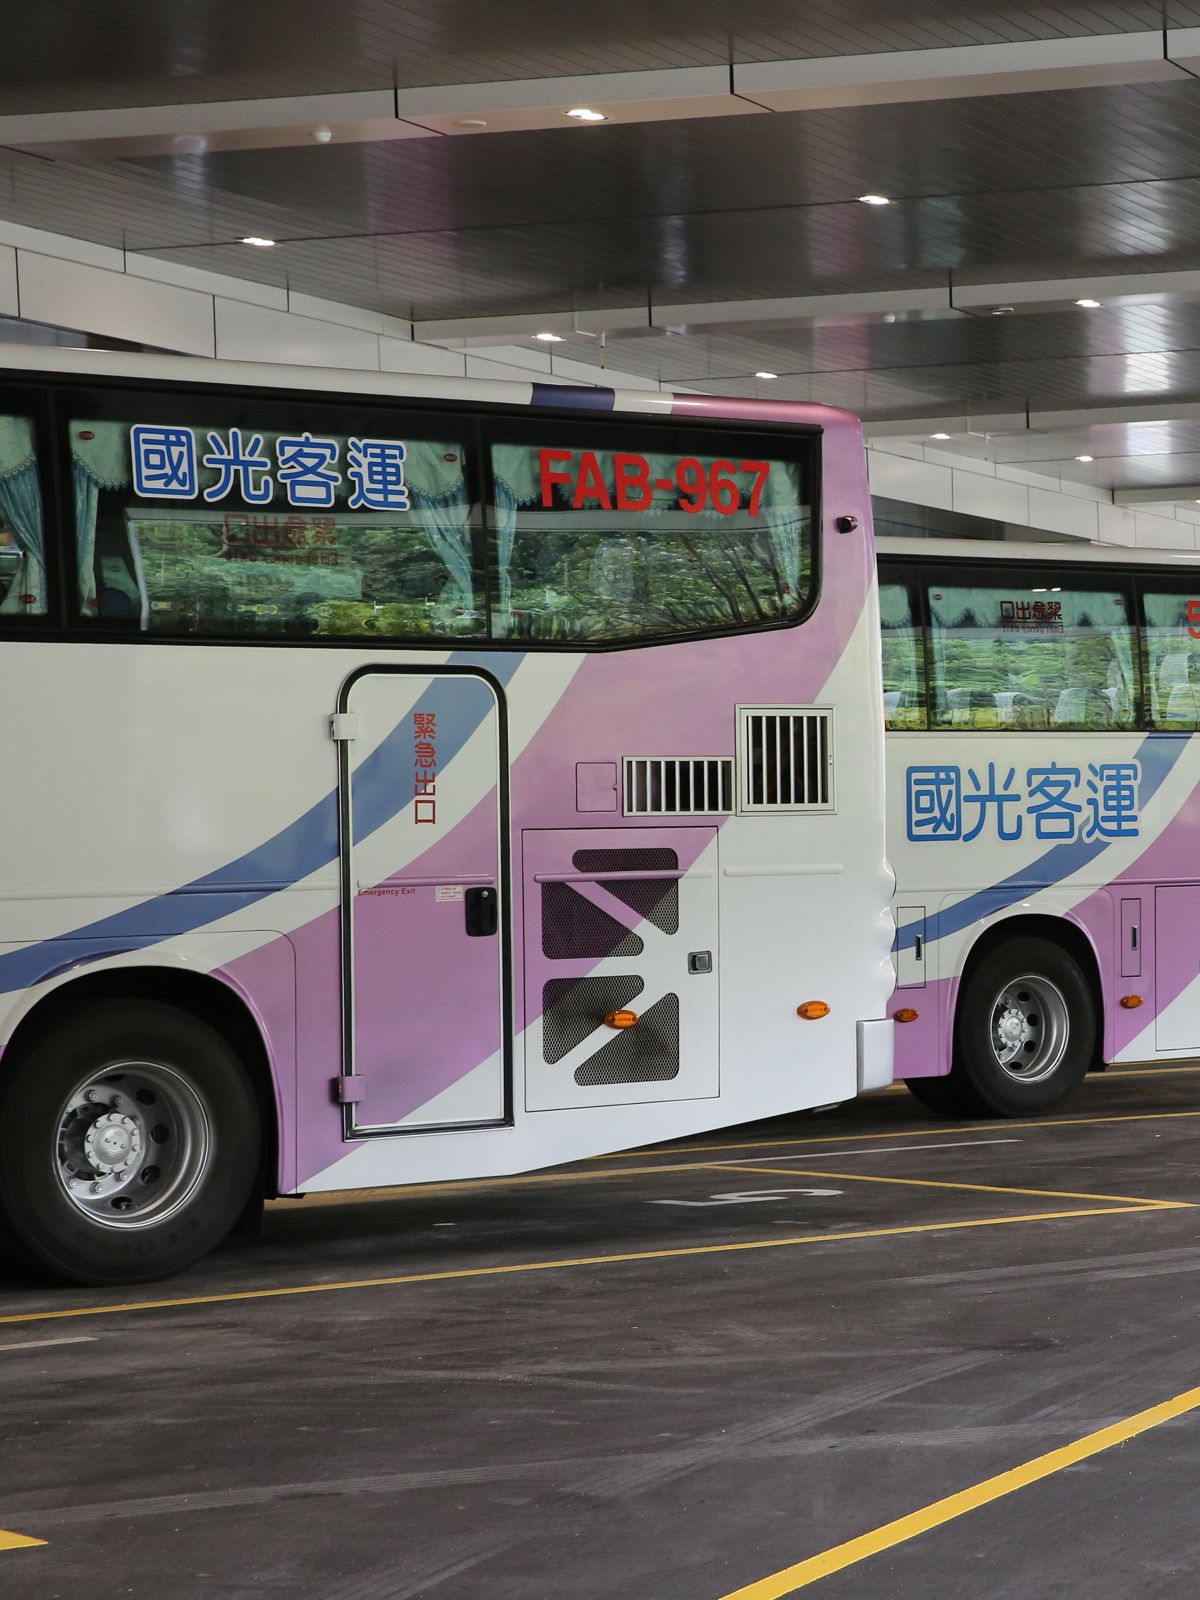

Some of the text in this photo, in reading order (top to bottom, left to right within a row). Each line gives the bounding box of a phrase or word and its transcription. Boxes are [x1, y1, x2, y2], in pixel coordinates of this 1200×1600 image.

[132, 425, 410, 511] 國光客運
[538, 448, 771, 517] FAB-967
[414, 713, 436, 824] 緊急出口
[905, 761, 1141, 843] 國光客運
[358, 888, 399, 897] Emergency
